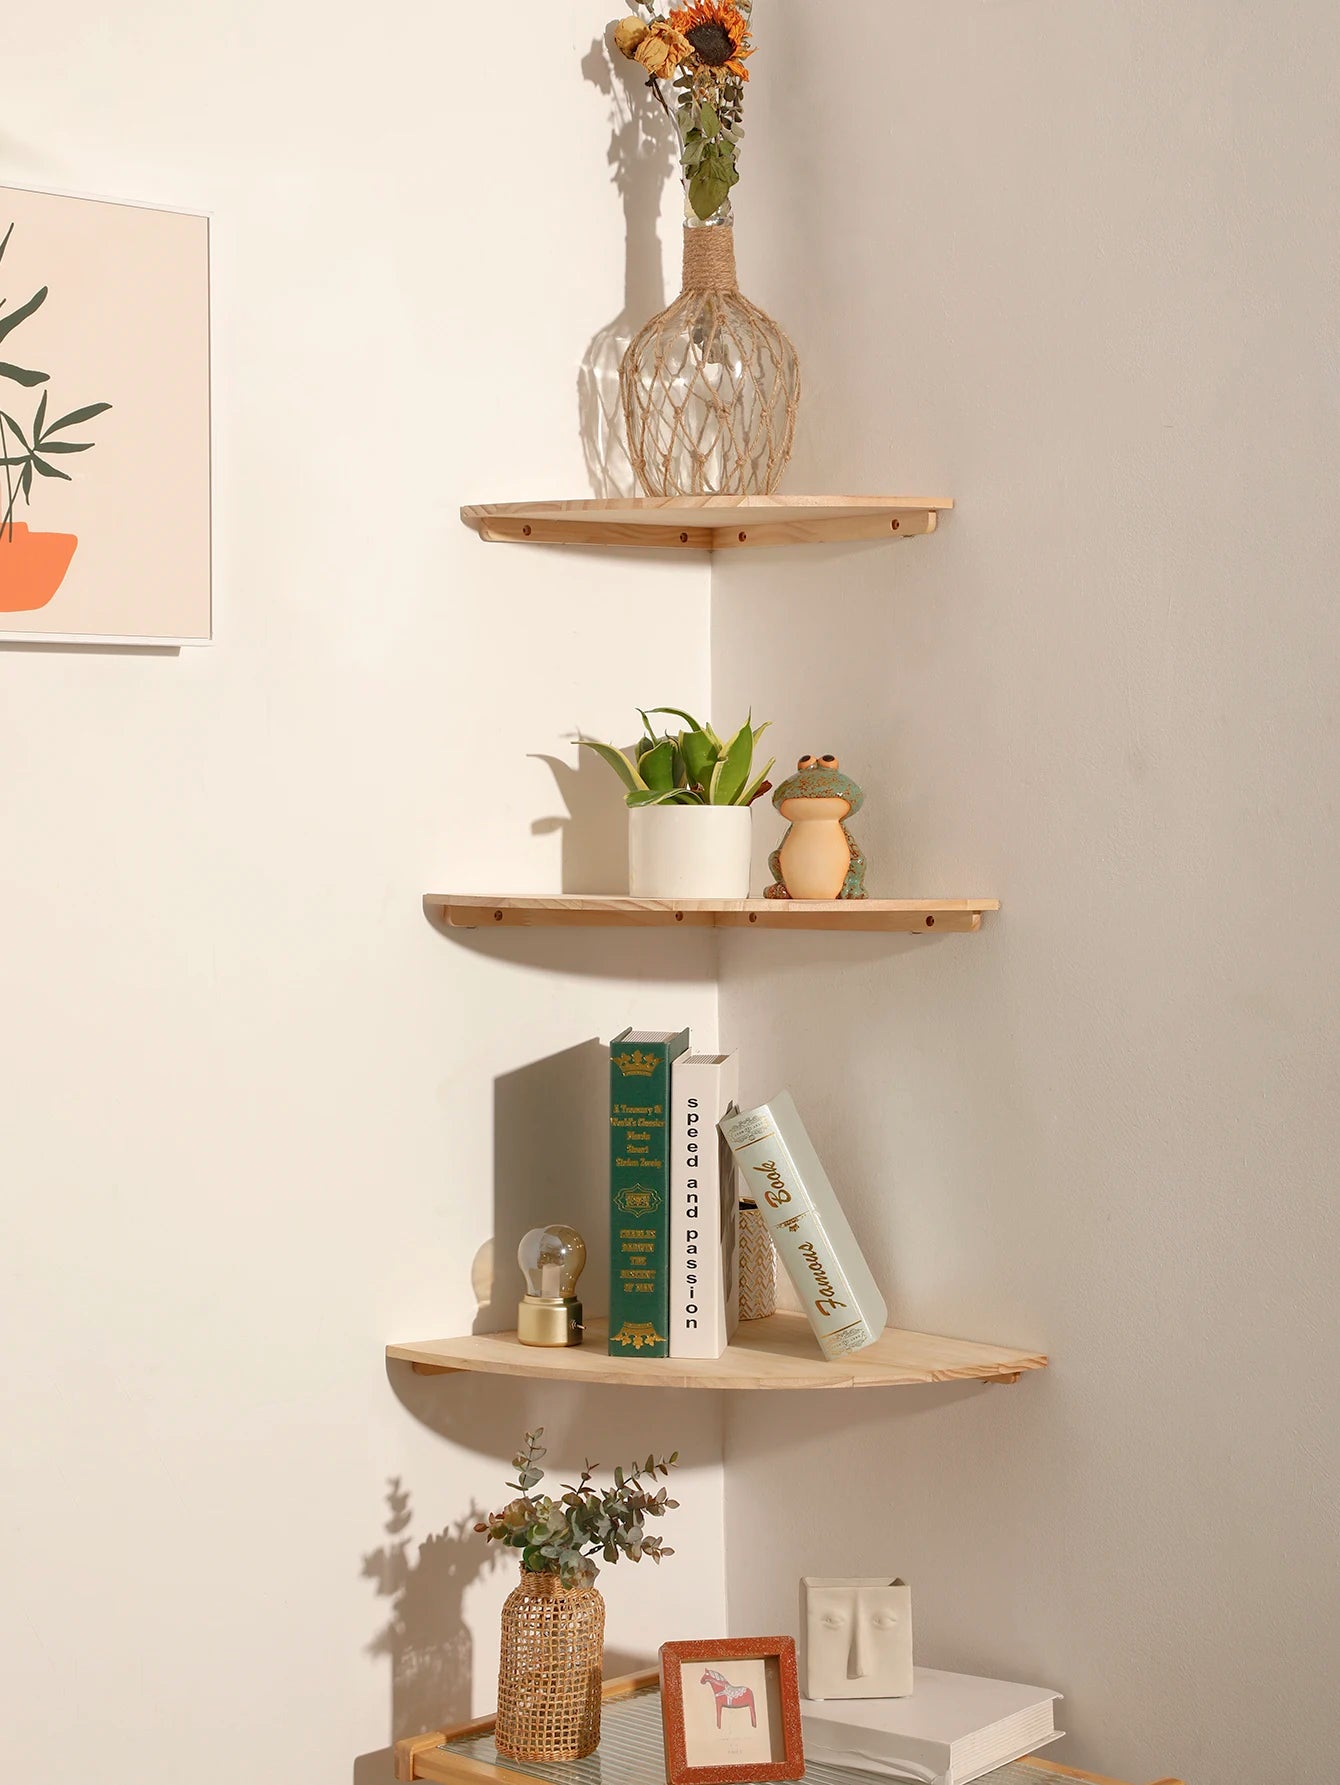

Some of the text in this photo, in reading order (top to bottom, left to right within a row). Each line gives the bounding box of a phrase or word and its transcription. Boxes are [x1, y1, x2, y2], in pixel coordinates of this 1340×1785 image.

[685, 1098, 699, 1329] speed and passion
[752, 1160, 792, 1209] Book
[798, 1241, 847, 1316] Famous
